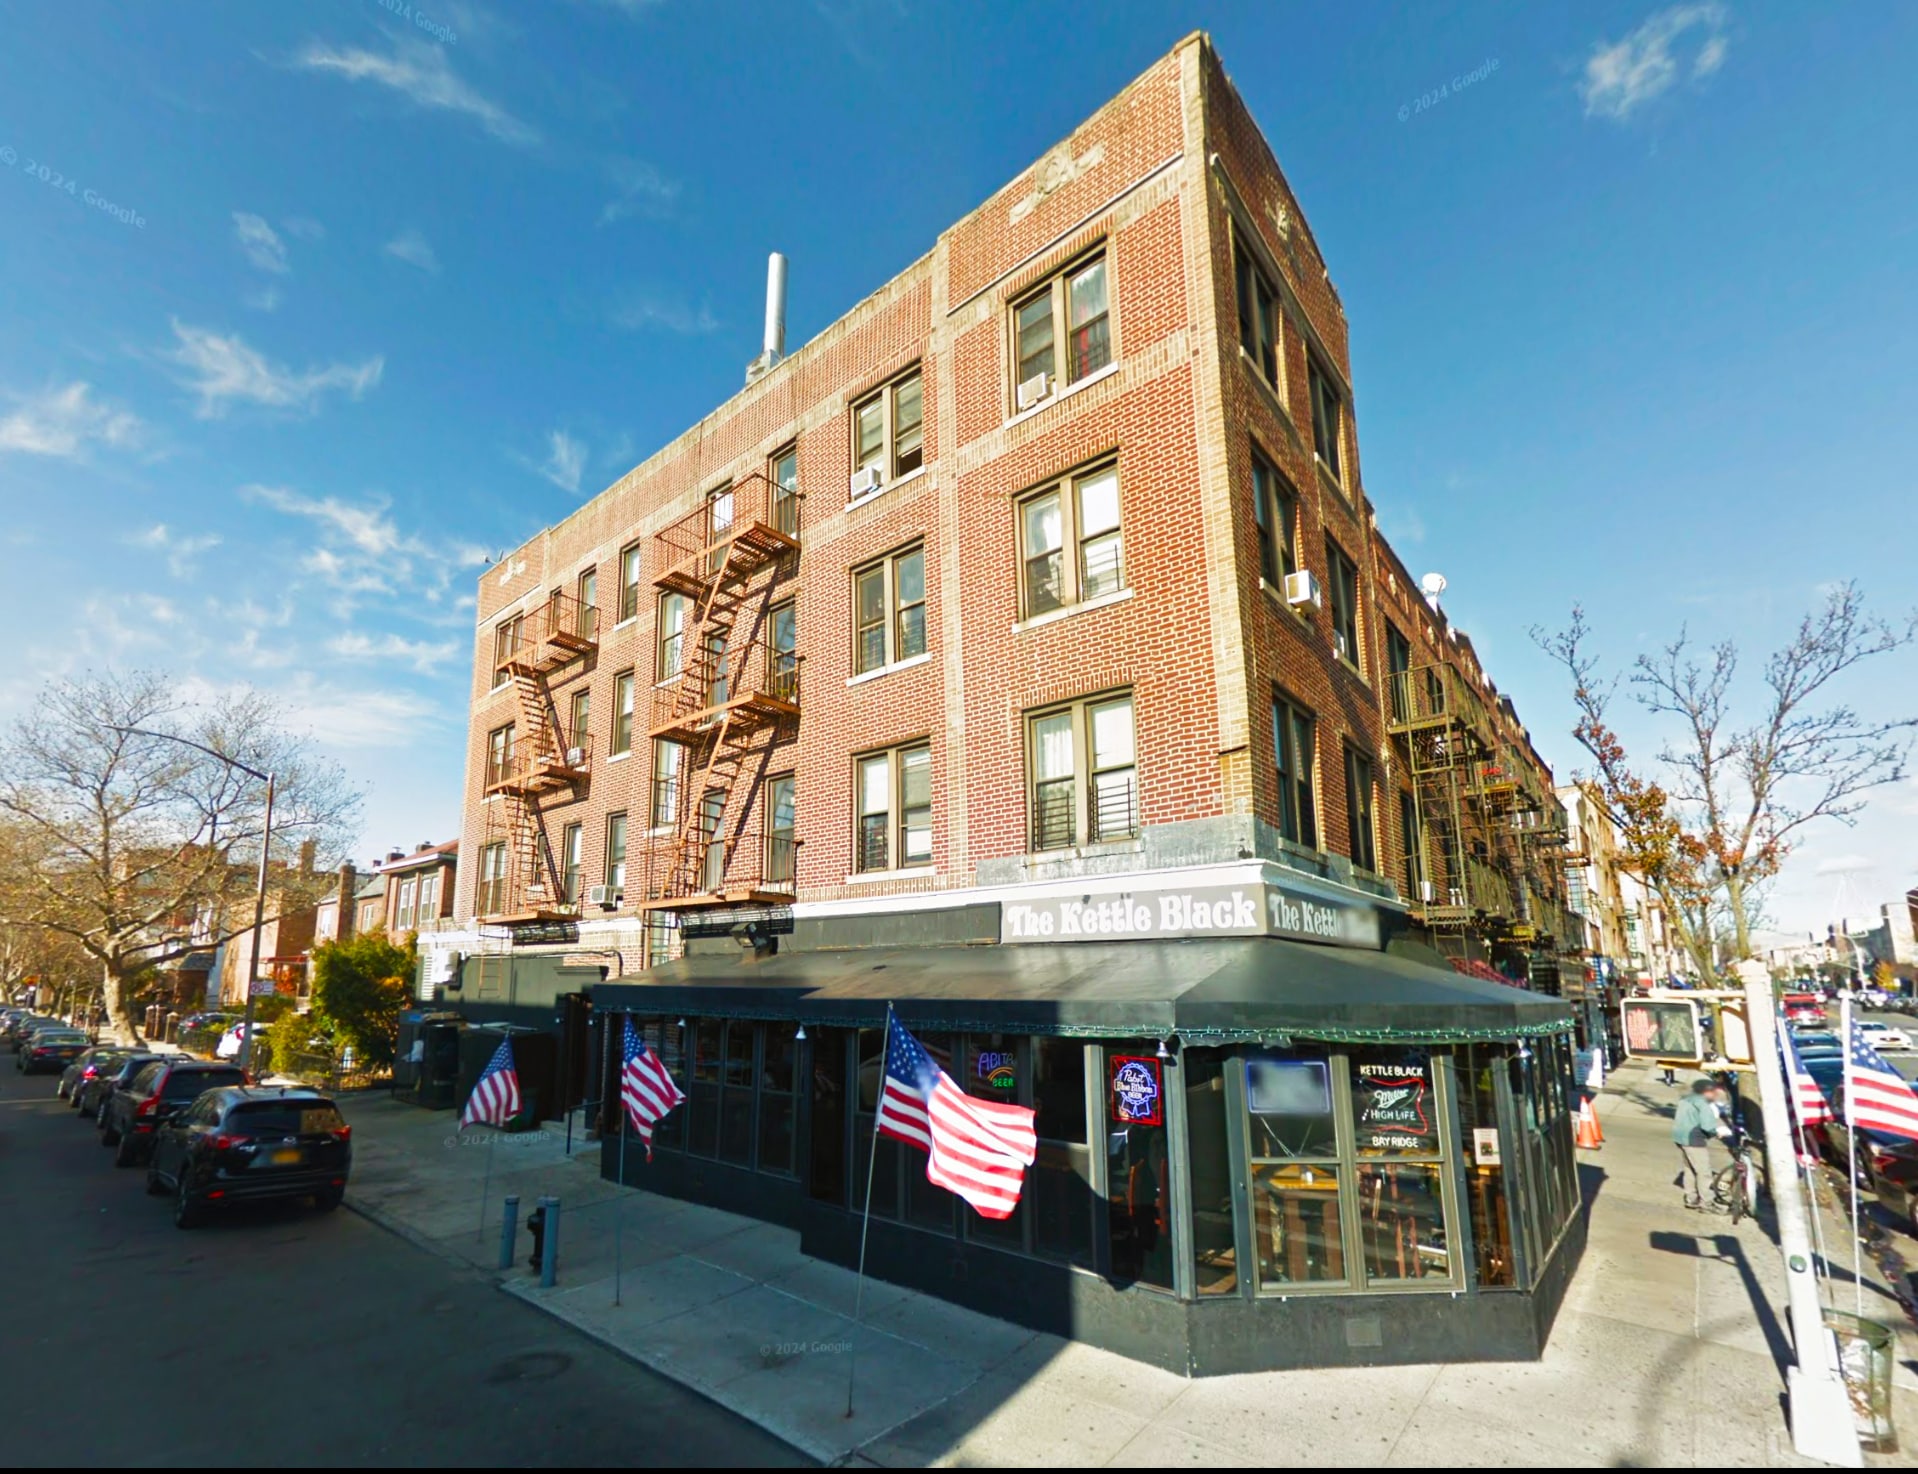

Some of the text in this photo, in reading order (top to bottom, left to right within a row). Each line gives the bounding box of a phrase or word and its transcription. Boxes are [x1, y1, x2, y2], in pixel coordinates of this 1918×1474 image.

[1007, 891, 1257, 937] The Kettle Black
[1269, 893, 1300, 931] The
[1360, 1065, 1424, 1077] KETTLE BLACK
[993, 1078, 1014, 1087] BEER
[1370, 1109, 1416, 1121] HIGH LIFE
[1372, 1136, 1419, 1148] BAY RIDGE
